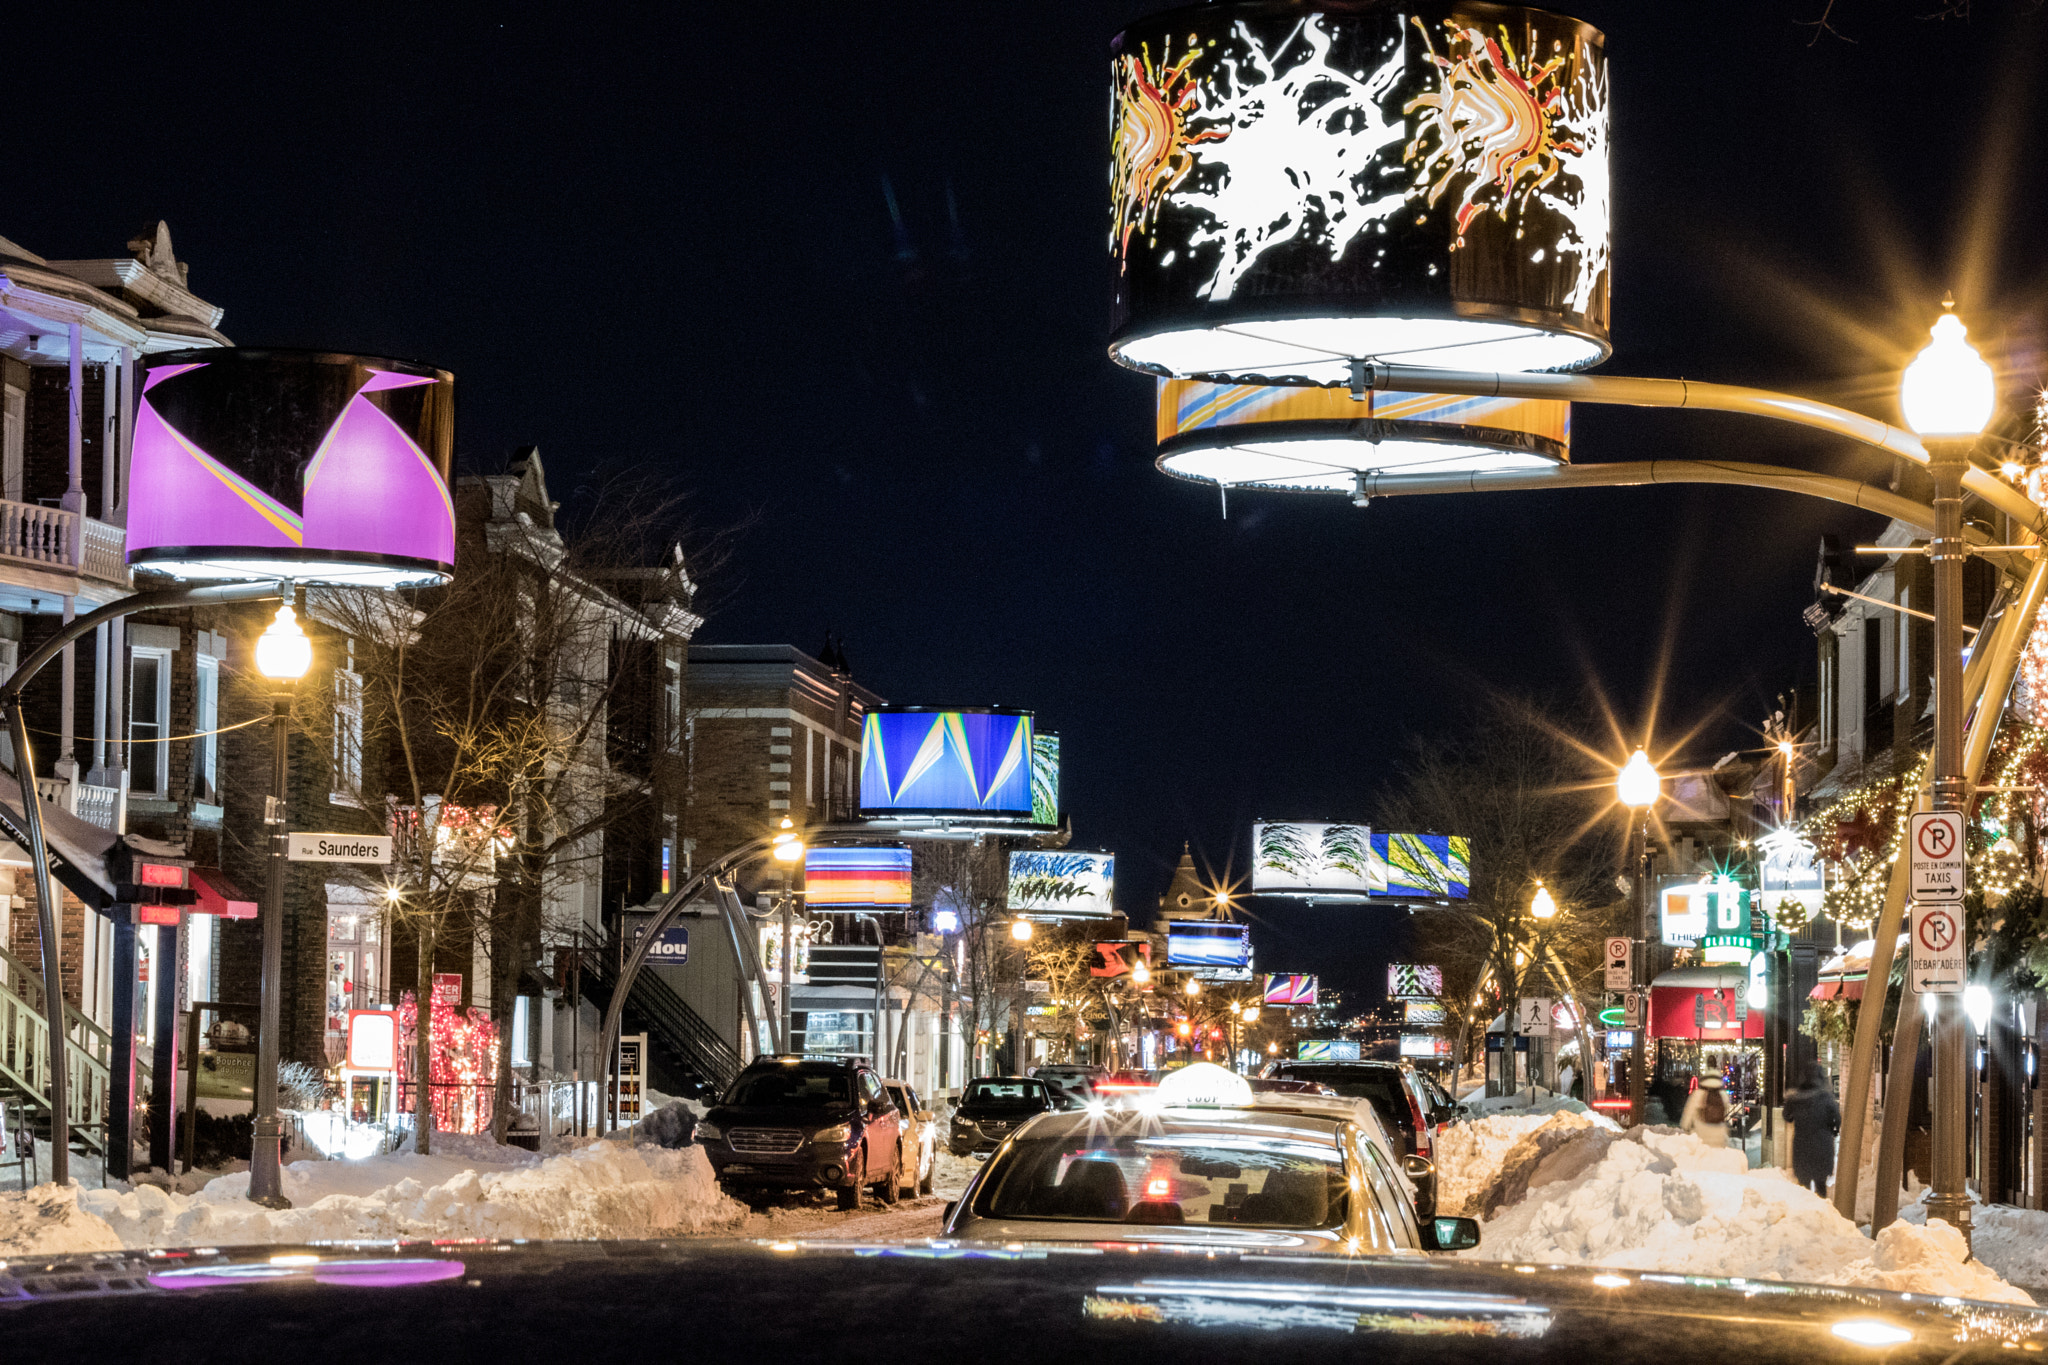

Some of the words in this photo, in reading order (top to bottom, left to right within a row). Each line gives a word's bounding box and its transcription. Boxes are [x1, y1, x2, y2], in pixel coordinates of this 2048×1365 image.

[301, 847, 313, 855] Rue
[318, 840, 379, 857] Saunders
[1913, 861, 1929, 870] POSTE
[1931, 861, 1938, 870] EN
[1939, 861, 1961, 870] COMMUN
[1925, 872, 1951, 883] TAXIS
[1705, 936, 1752, 947] BLAXTON
